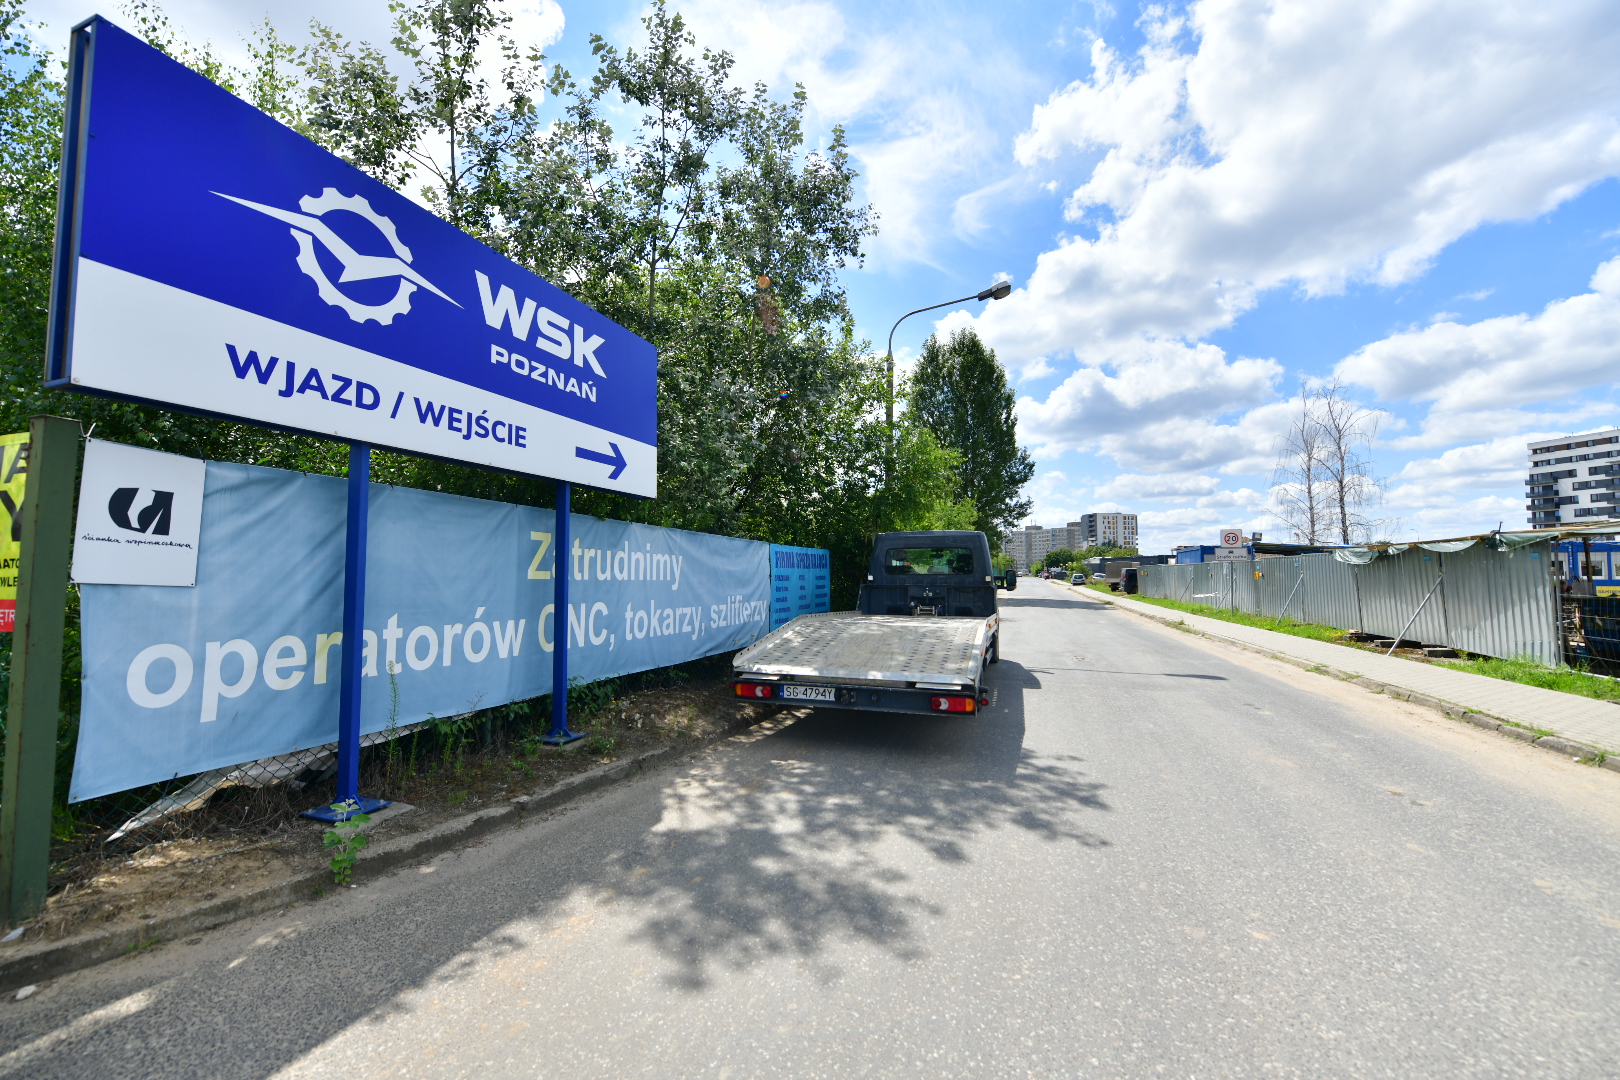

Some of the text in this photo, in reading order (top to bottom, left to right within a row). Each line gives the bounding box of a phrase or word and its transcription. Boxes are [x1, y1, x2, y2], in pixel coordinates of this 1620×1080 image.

[474, 269, 607, 378] WSK
[225, 342, 527, 449] WJAZD / WEJŚCIE
[490, 343, 597, 403] POZNAŃ
[81, 533, 121, 544] ścianka
[625, 599, 705, 641] tokarzy,
[710, 594, 767, 630] szlifierzy
[785, 686, 833, 700] SG 4794Y
